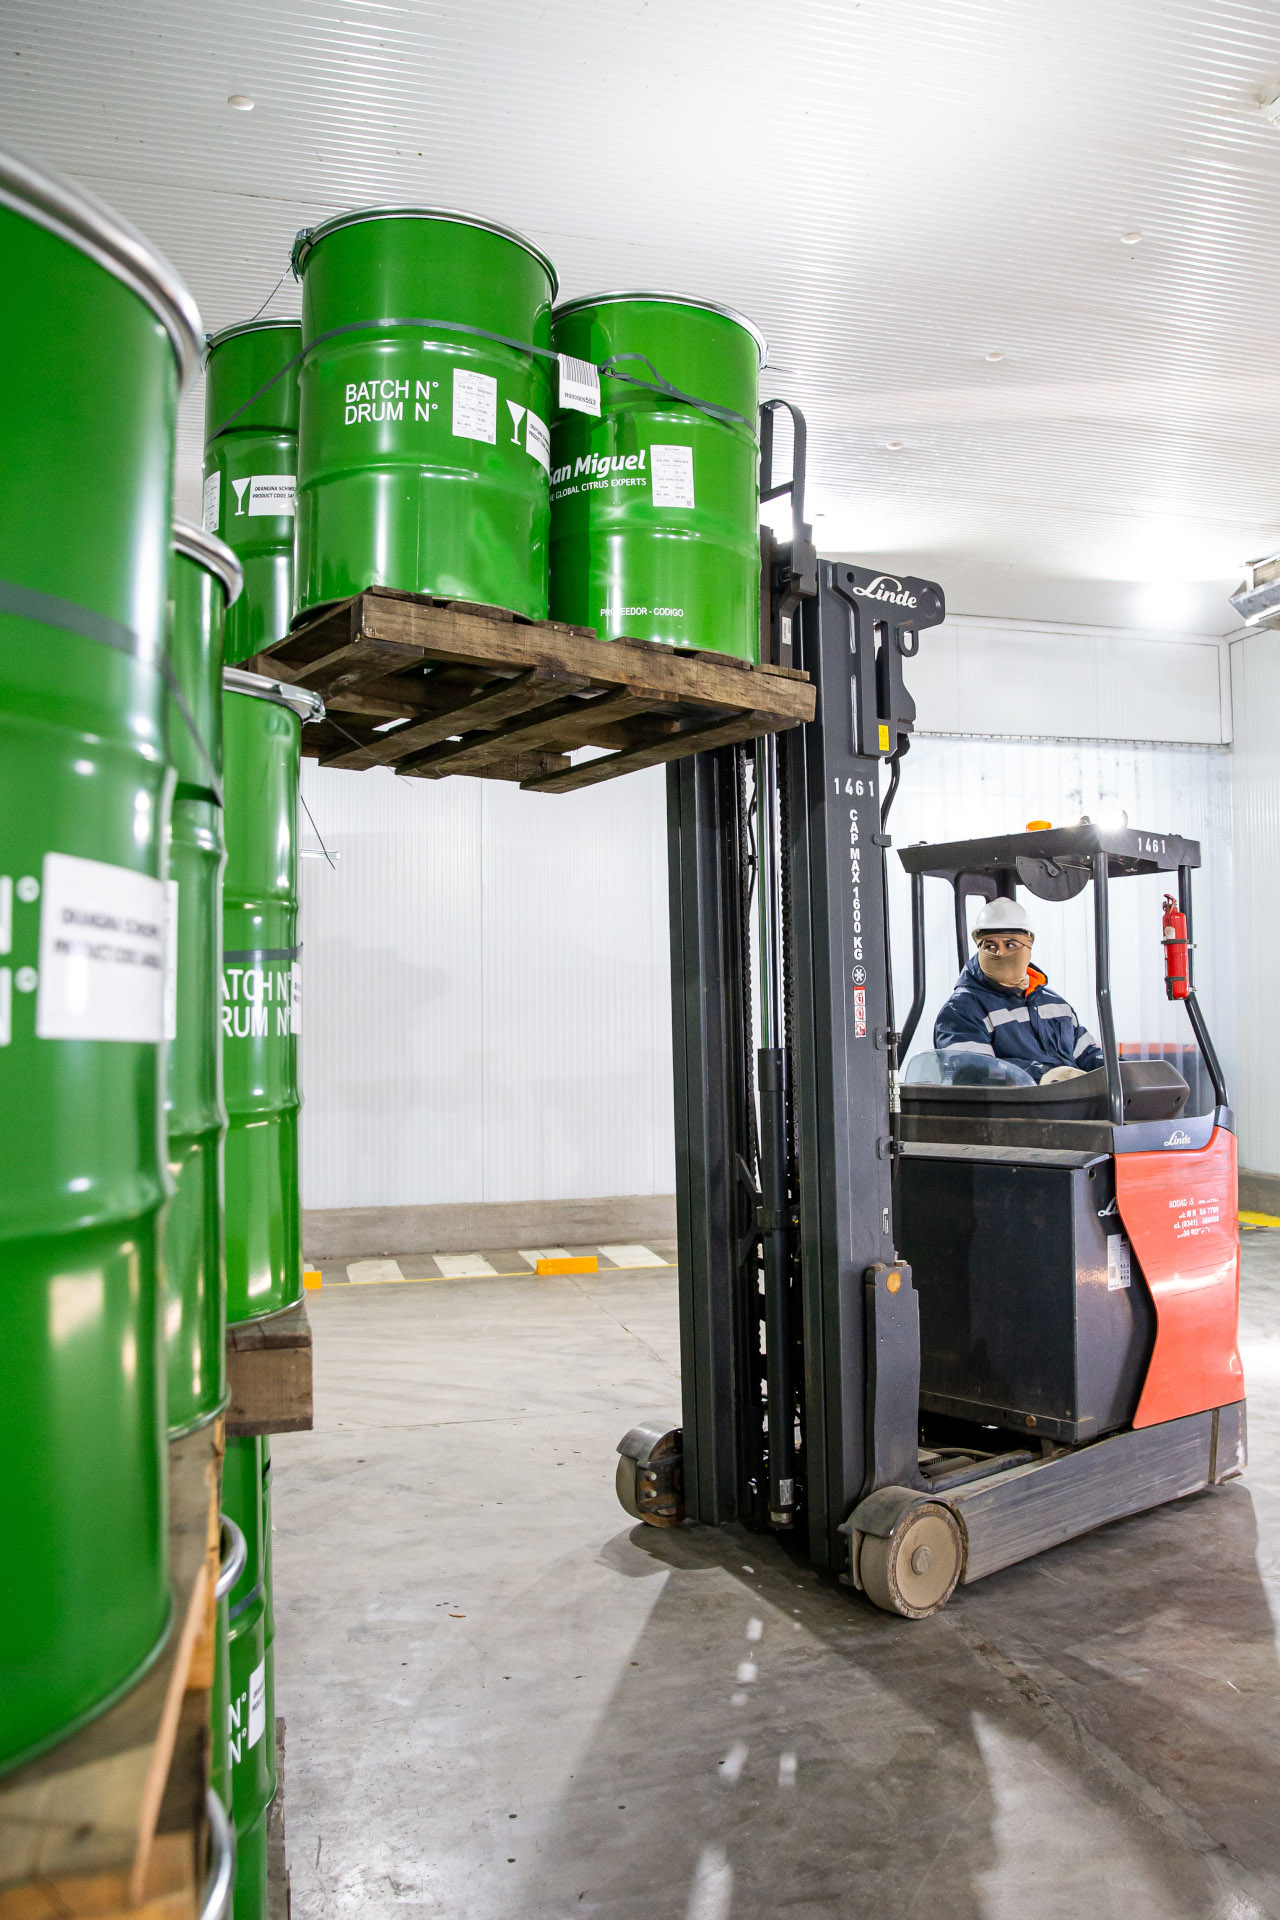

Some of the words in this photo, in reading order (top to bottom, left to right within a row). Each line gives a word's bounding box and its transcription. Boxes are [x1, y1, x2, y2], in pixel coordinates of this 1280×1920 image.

[346, 380, 409, 403] BATCH
[416, 380, 439, 400] N°
[345, 402, 403, 425] DRUM
[415, 402, 438, 422] N°
[574, 449, 646, 478] Miguel
[556, 485, 580, 500] GLOBAL
[581, 480, 609, 491] CITRUS
[611, 478, 647, 487] EXPERTS
[853, 576, 917, 609] Linde
[601, 607, 648, 617] PROEEDOR
[654, 608, 684, 617] CODIGO
[834, 777, 874, 797] 1461
[849, 809, 859, 845] CAP
[1138, 837, 1166, 854] 1461
[850, 848, 861, 883] MAX
[852, 886, 861, 933] 1600
[853, 937, 863, 960] KG
[221, 968, 273, 1001] ATCH
[221, 1006, 268, 1038] RUM
[1164, 1130, 1191, 1146] Linde
